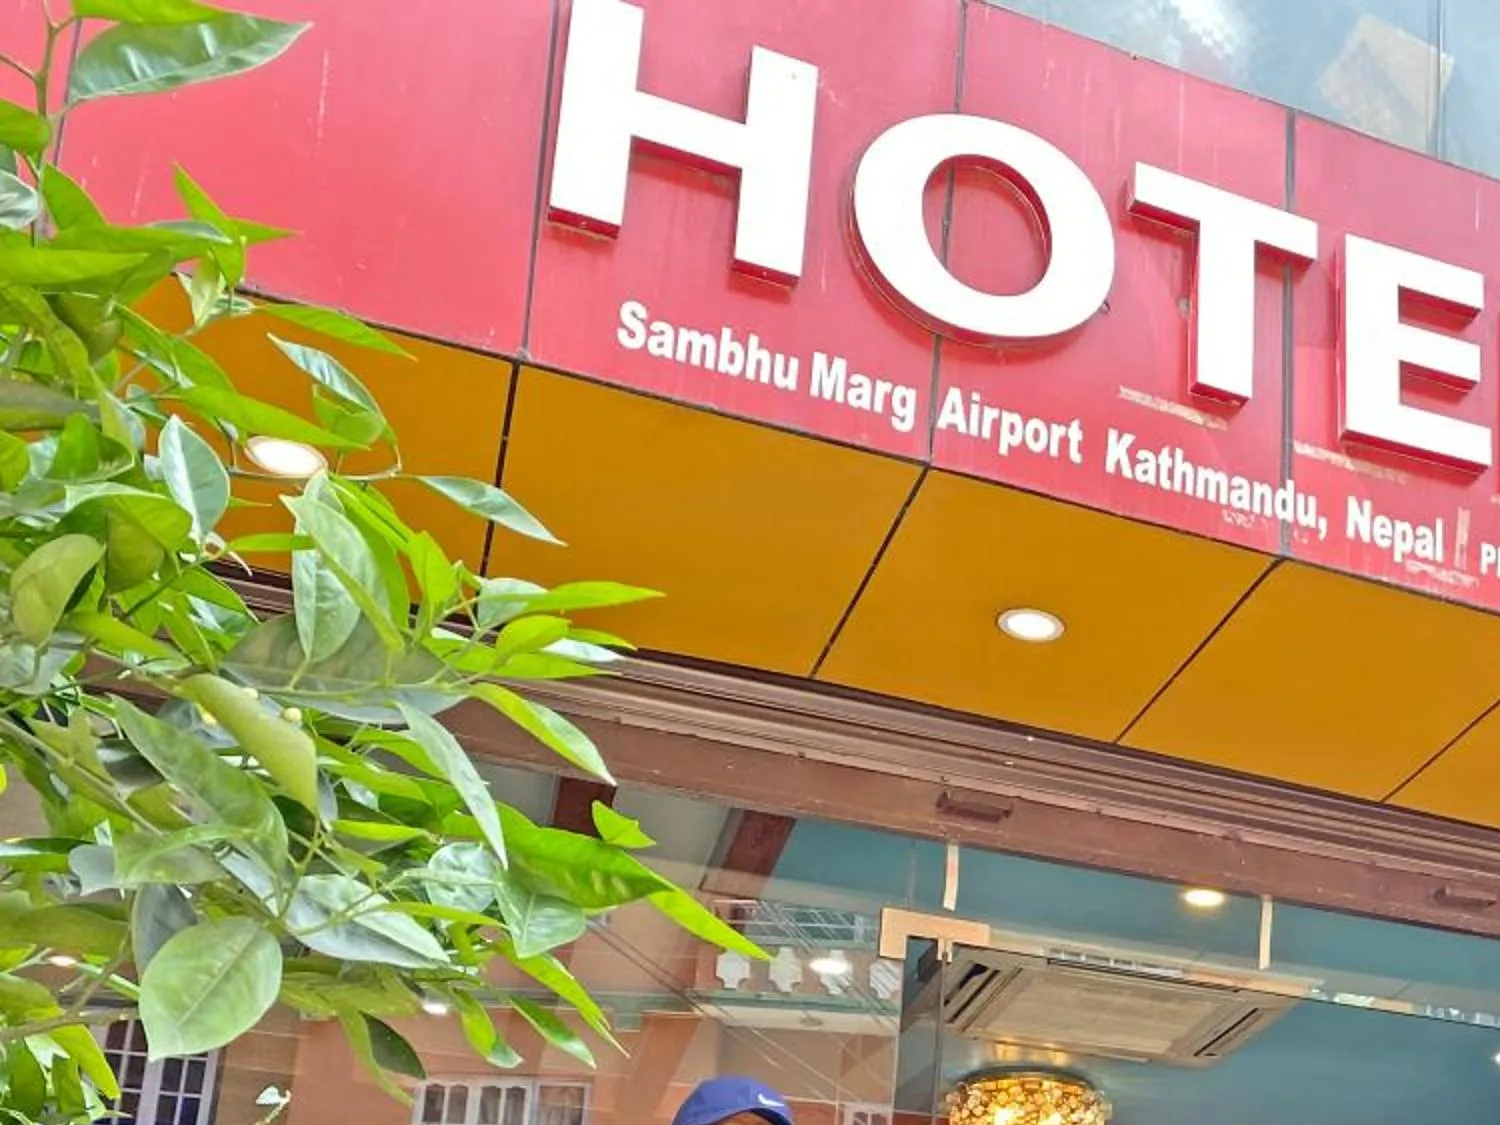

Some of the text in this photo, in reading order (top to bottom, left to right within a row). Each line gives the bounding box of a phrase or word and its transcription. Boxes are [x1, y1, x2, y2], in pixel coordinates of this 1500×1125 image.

[617, 299, 799, 389] Sambhu
[810, 351, 917, 433] Marg
[938, 386, 1084, 464] Airport
[1105, 428, 1328, 539] Kathmandu,
[1346, 499, 1445, 563] Nepal
